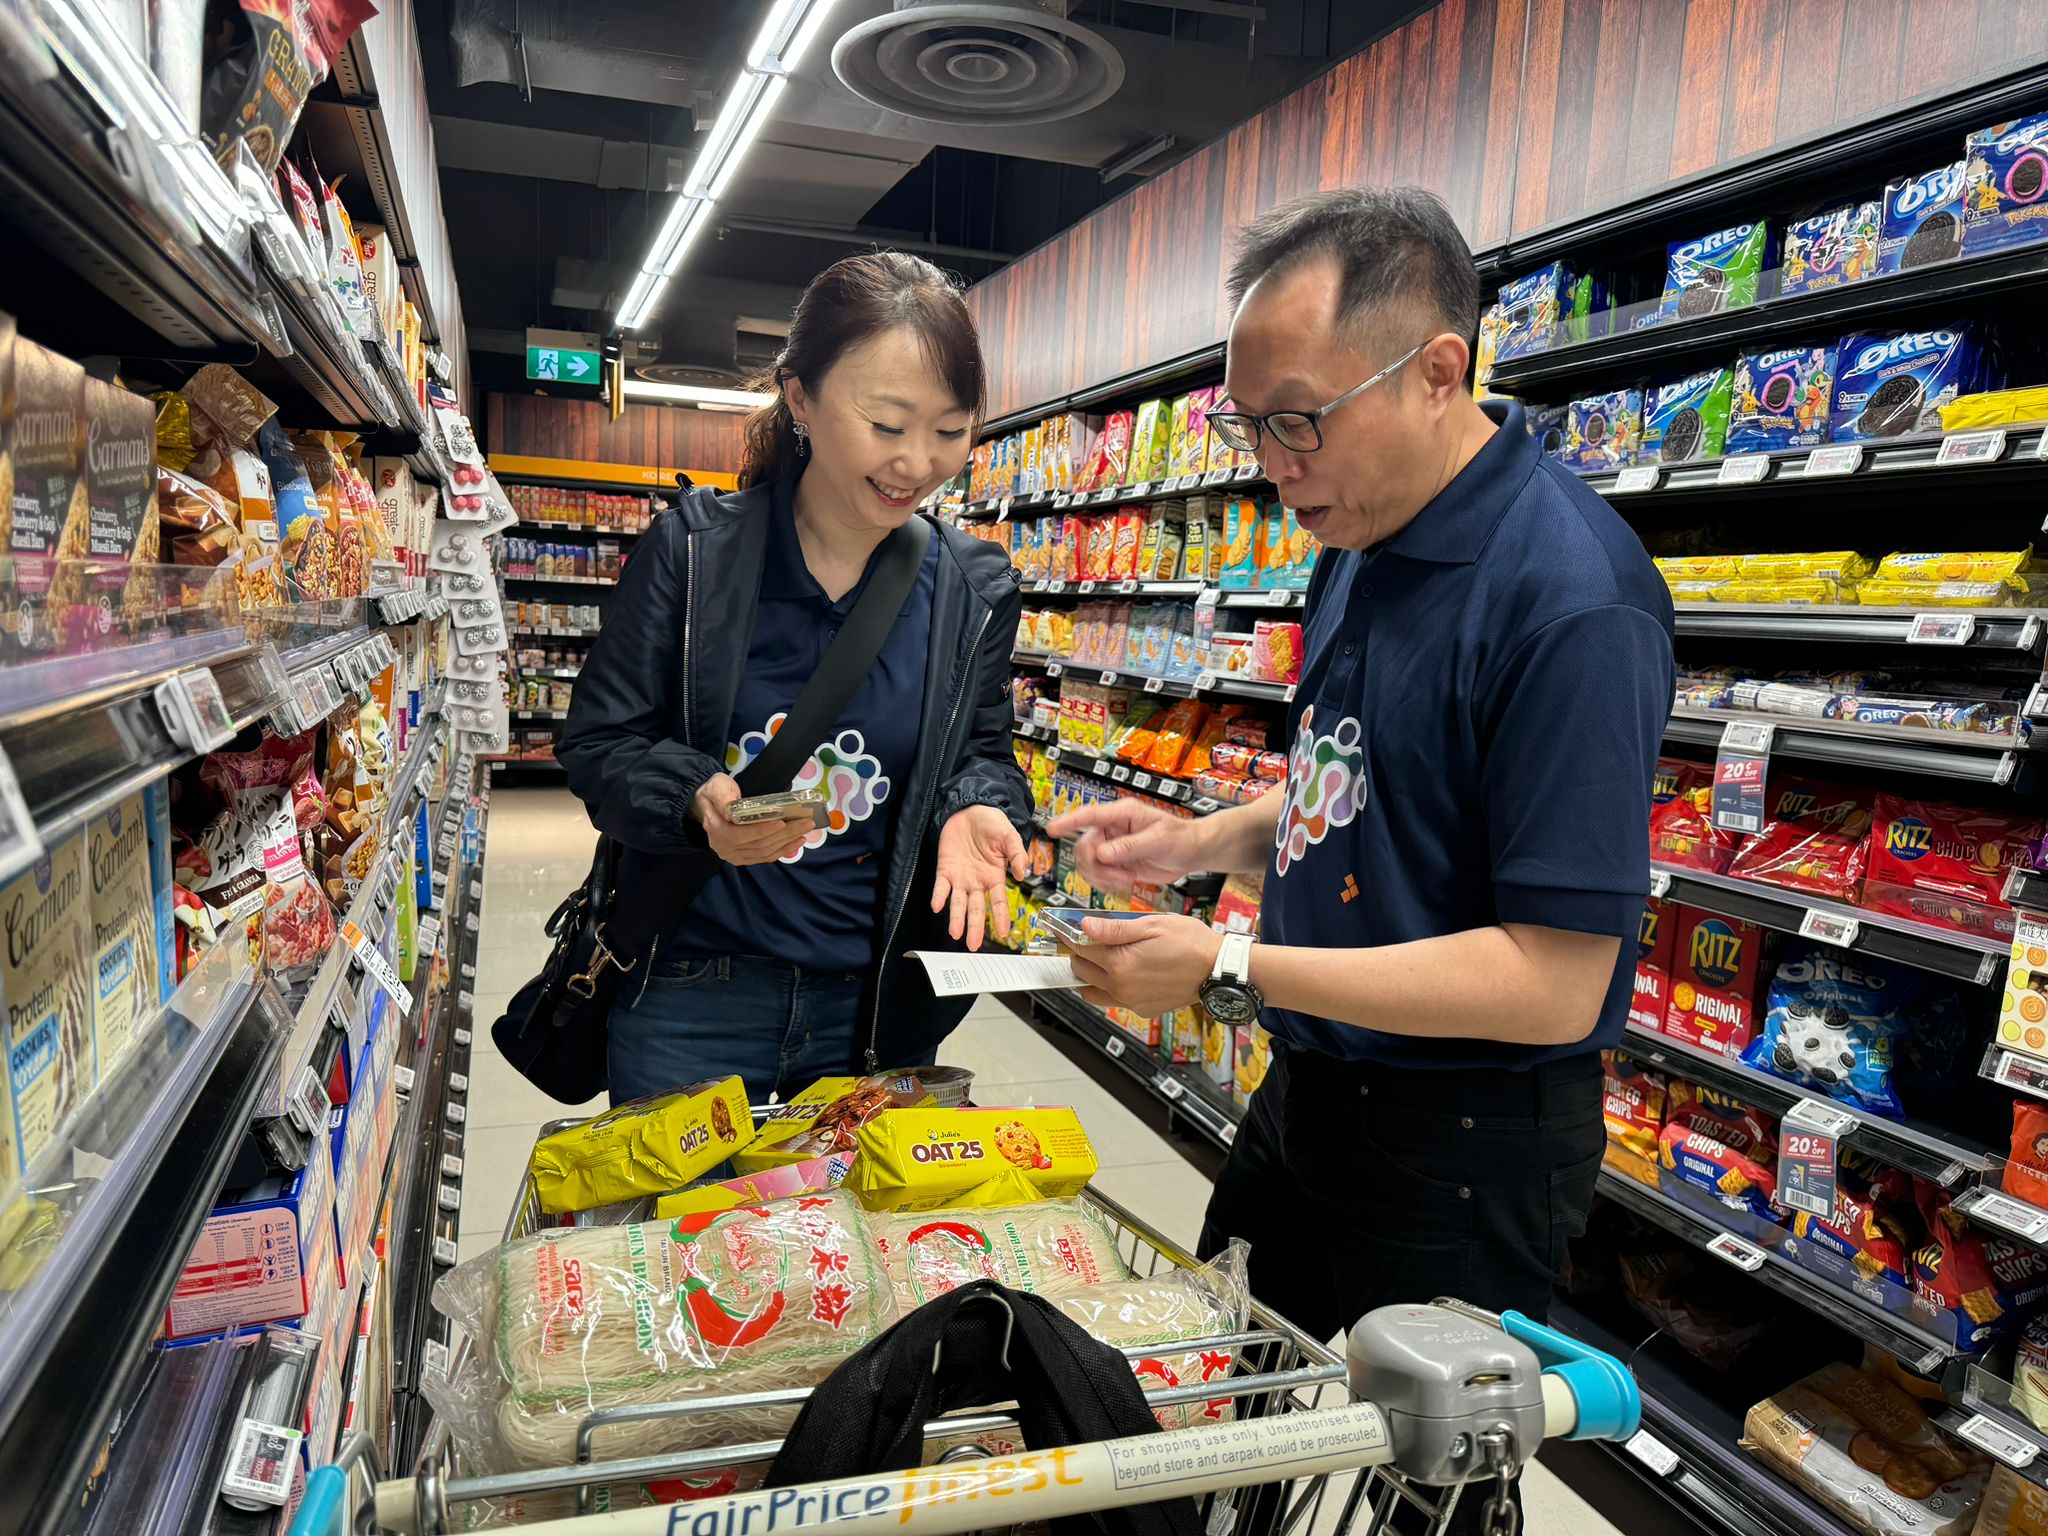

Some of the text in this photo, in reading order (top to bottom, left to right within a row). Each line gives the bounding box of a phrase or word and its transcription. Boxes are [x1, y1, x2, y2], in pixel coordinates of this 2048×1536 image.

[1672, 224, 1752, 262] OREO
[1759, 348, 1807, 369] OREO
[1858, 329, 1954, 370] OREO
[87, 417, 150, 473] Carman's
[642, 471, 676, 480] KORE
[1858, 709, 1899, 721] OREO
[1723, 762, 1744, 778] 20
[1744, 769, 1758, 777] OFF
[1886, 821, 1932, 851] RITZ
[89, 809, 145, 894] Carman's
[5, 849, 81, 968] Carman's
[95, 908, 129, 945] Protein
[1689, 925, 1742, 972] RITZ
[1776, 961, 1886, 989] OREO
[8, 980, 54, 1038] Protein
[12, 1028, 50, 1072] COOKIES
[1606, 1097, 1632, 1119] CHIPS
[680, 1123, 710, 1154] OAT 25
[1690, 1114, 1748, 1147] TOASTED
[911, 1140, 985, 1164] OAT 25
[1686, 1133, 1726, 1158] CHIPS
[1787, 1137, 1810, 1154] 20
[1811, 1147, 1825, 1155] OFF
[1683, 1156, 1715, 1178] ORIGINAL
[1811, 1227, 1846, 1256] ORIGINAL
[661, 1250, 669, 1265] SUN
[1993, 1252, 2048, 1283] CHIPS
[662, 1265, 673, 1294] BRAND
[1855, 1378, 1915, 1419] PEANUT
[1114, 1409, 1377, 1461] For shopping use only. Unauthorised use
[1768, 1420, 1788, 1436] 550g
[253, 1457, 266, 1481] SPECIAL
[1118, 1427, 1381, 1482] beyond store and carpark could be prosecuted.
[665, 1448, 1084, 1536] FairPrice finest
